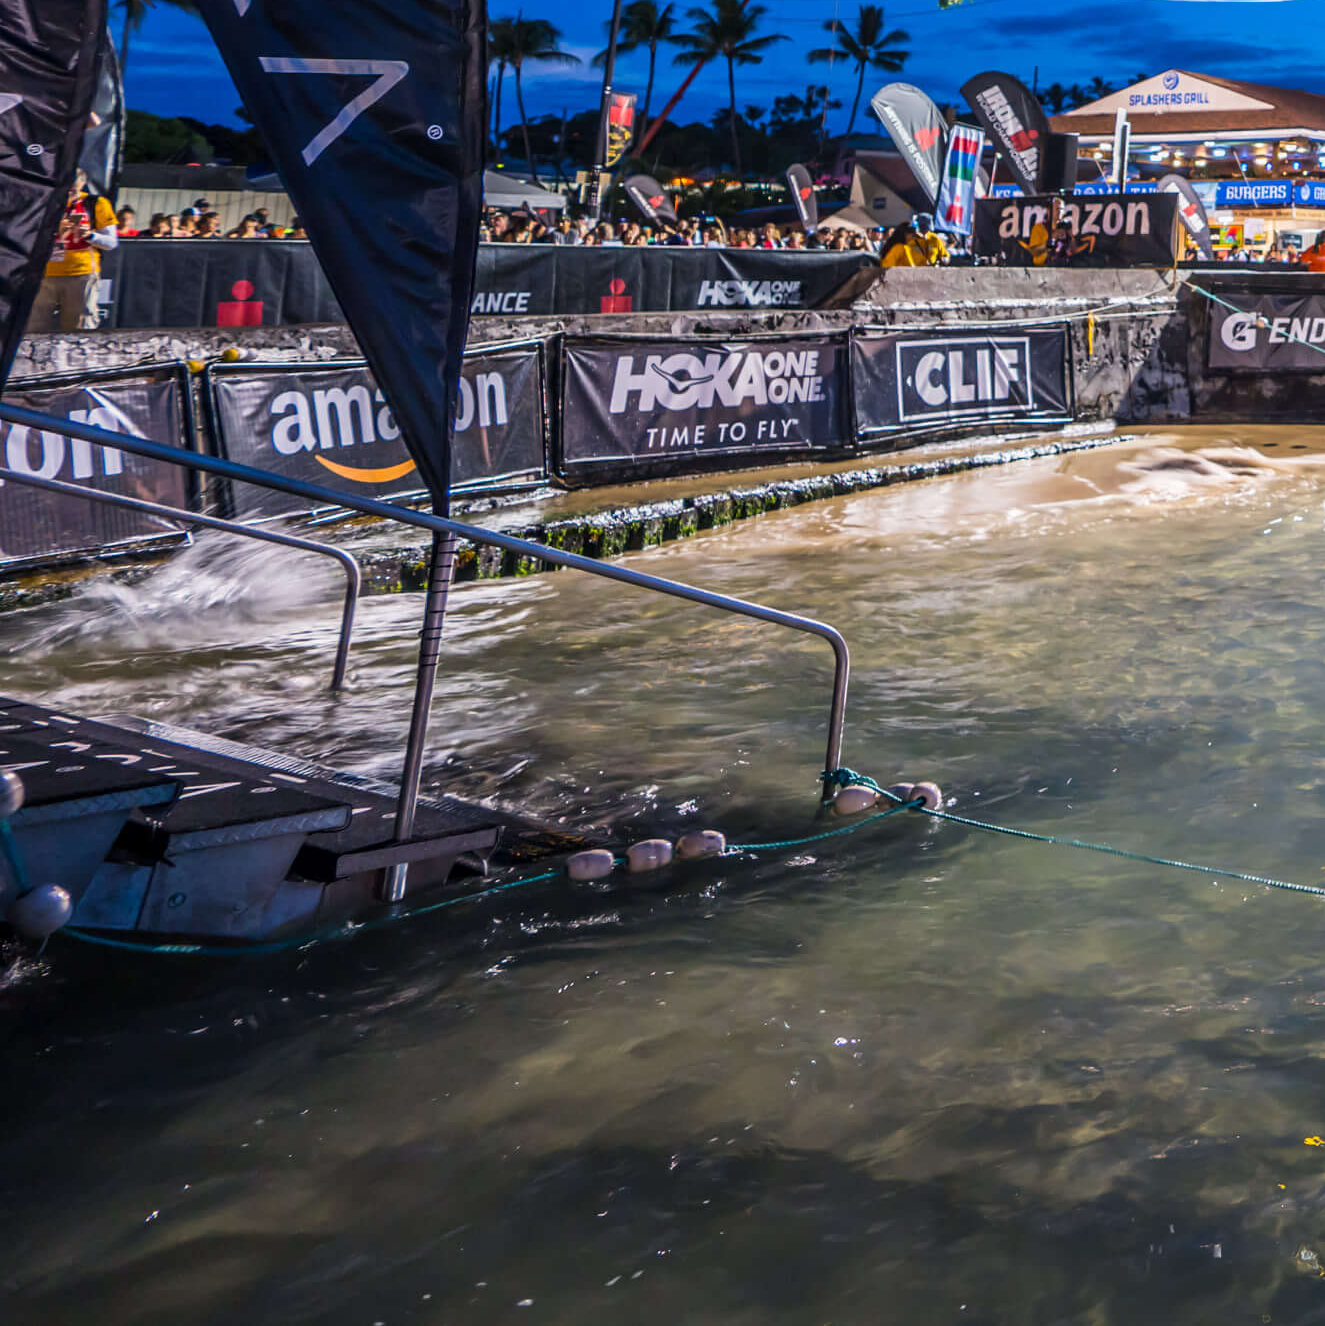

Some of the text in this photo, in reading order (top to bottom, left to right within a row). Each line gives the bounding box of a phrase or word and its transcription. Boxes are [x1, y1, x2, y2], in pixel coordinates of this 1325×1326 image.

[1129, 92, 1209, 106] SPLASHERS GRILL
[1226, 185, 1287, 200] BURGERS
[609, 350, 820, 414] HOKA ONE
[915, 349, 1018, 406] CLIF
[271, 371, 508, 455] amaon
[646, 425, 705, 448] TIME
[718, 422, 746, 443] TO
